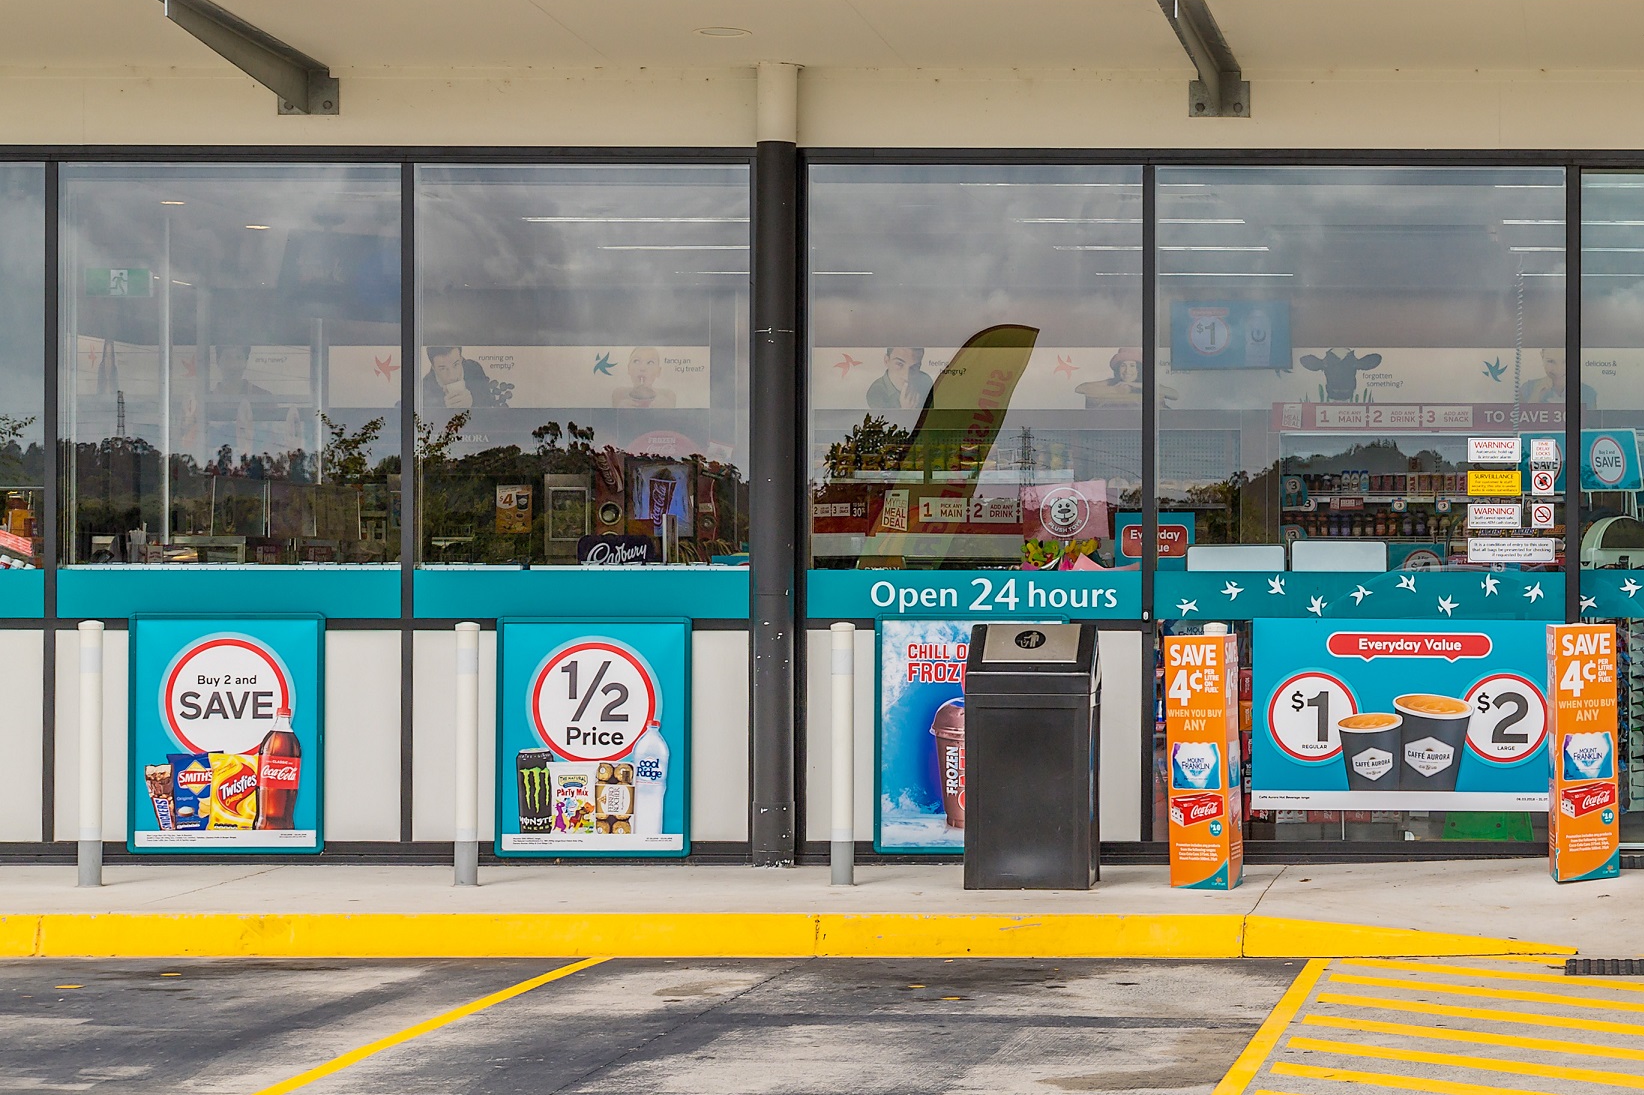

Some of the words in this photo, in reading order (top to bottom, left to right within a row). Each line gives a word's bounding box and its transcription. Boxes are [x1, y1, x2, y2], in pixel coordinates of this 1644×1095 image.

[939, 368, 966, 376] hungry?
[1362, 372, 1392, 381] forgotten
[1366, 380, 1403, 388] something?
[1484, 411, 1505, 422] TO
[1510, 410, 1549, 423] SAVE
[1595, 457, 1621, 467] SAVE
[499, 493, 513, 506] $4
[940, 509, 963, 517] MAIN
[990, 510, 1013, 518] DRINK
[1048, 521, 1068, 533] PLUSH
[586, 542, 647, 564] Cadbury
[870, 581, 958, 614] Open
[969, 578, 1019, 611] 24
[1028, 580, 1118, 608] hours
[1358, 638, 1421, 653] Everyday
[1424, 639, 1462, 651] Value
[1562, 633, 1610, 656] SAVE
[907, 643, 950, 660] CHILL
[1170, 644, 1216, 666] SAVE
[197, 675, 221, 687] Buy
[224, 675, 231, 684] 2
[235, 675, 256, 685] and
[180, 691, 273, 720] SAVE
[1559, 700, 1582, 709] WHEN
[1584, 700, 1598, 708] YOU
[1168, 709, 1189, 717] WHEN
[1191, 709, 1205, 717] YOU
[1292, 691, 1329, 742] $1
[1477, 692, 1528, 743] $2
[1576, 709, 1599, 721] ANY
[1184, 720, 1206, 730] ANY
[566, 726, 624, 746] Price
[1574, 752, 1602, 760] FRANKLIN
[1182, 762, 1210, 770] FRANKLIN
[1371, 759, 1391, 767] AURORA
[261, 765, 297, 781] Coca-Cola
[946, 746, 959, 796] FROZEN
[219, 774, 257, 801] Twisties
[1582, 791, 1610, 809] Coca-Cola
[155, 800, 171, 829] SNICKERS
[1191, 802, 1218, 818] Coca-Cola
